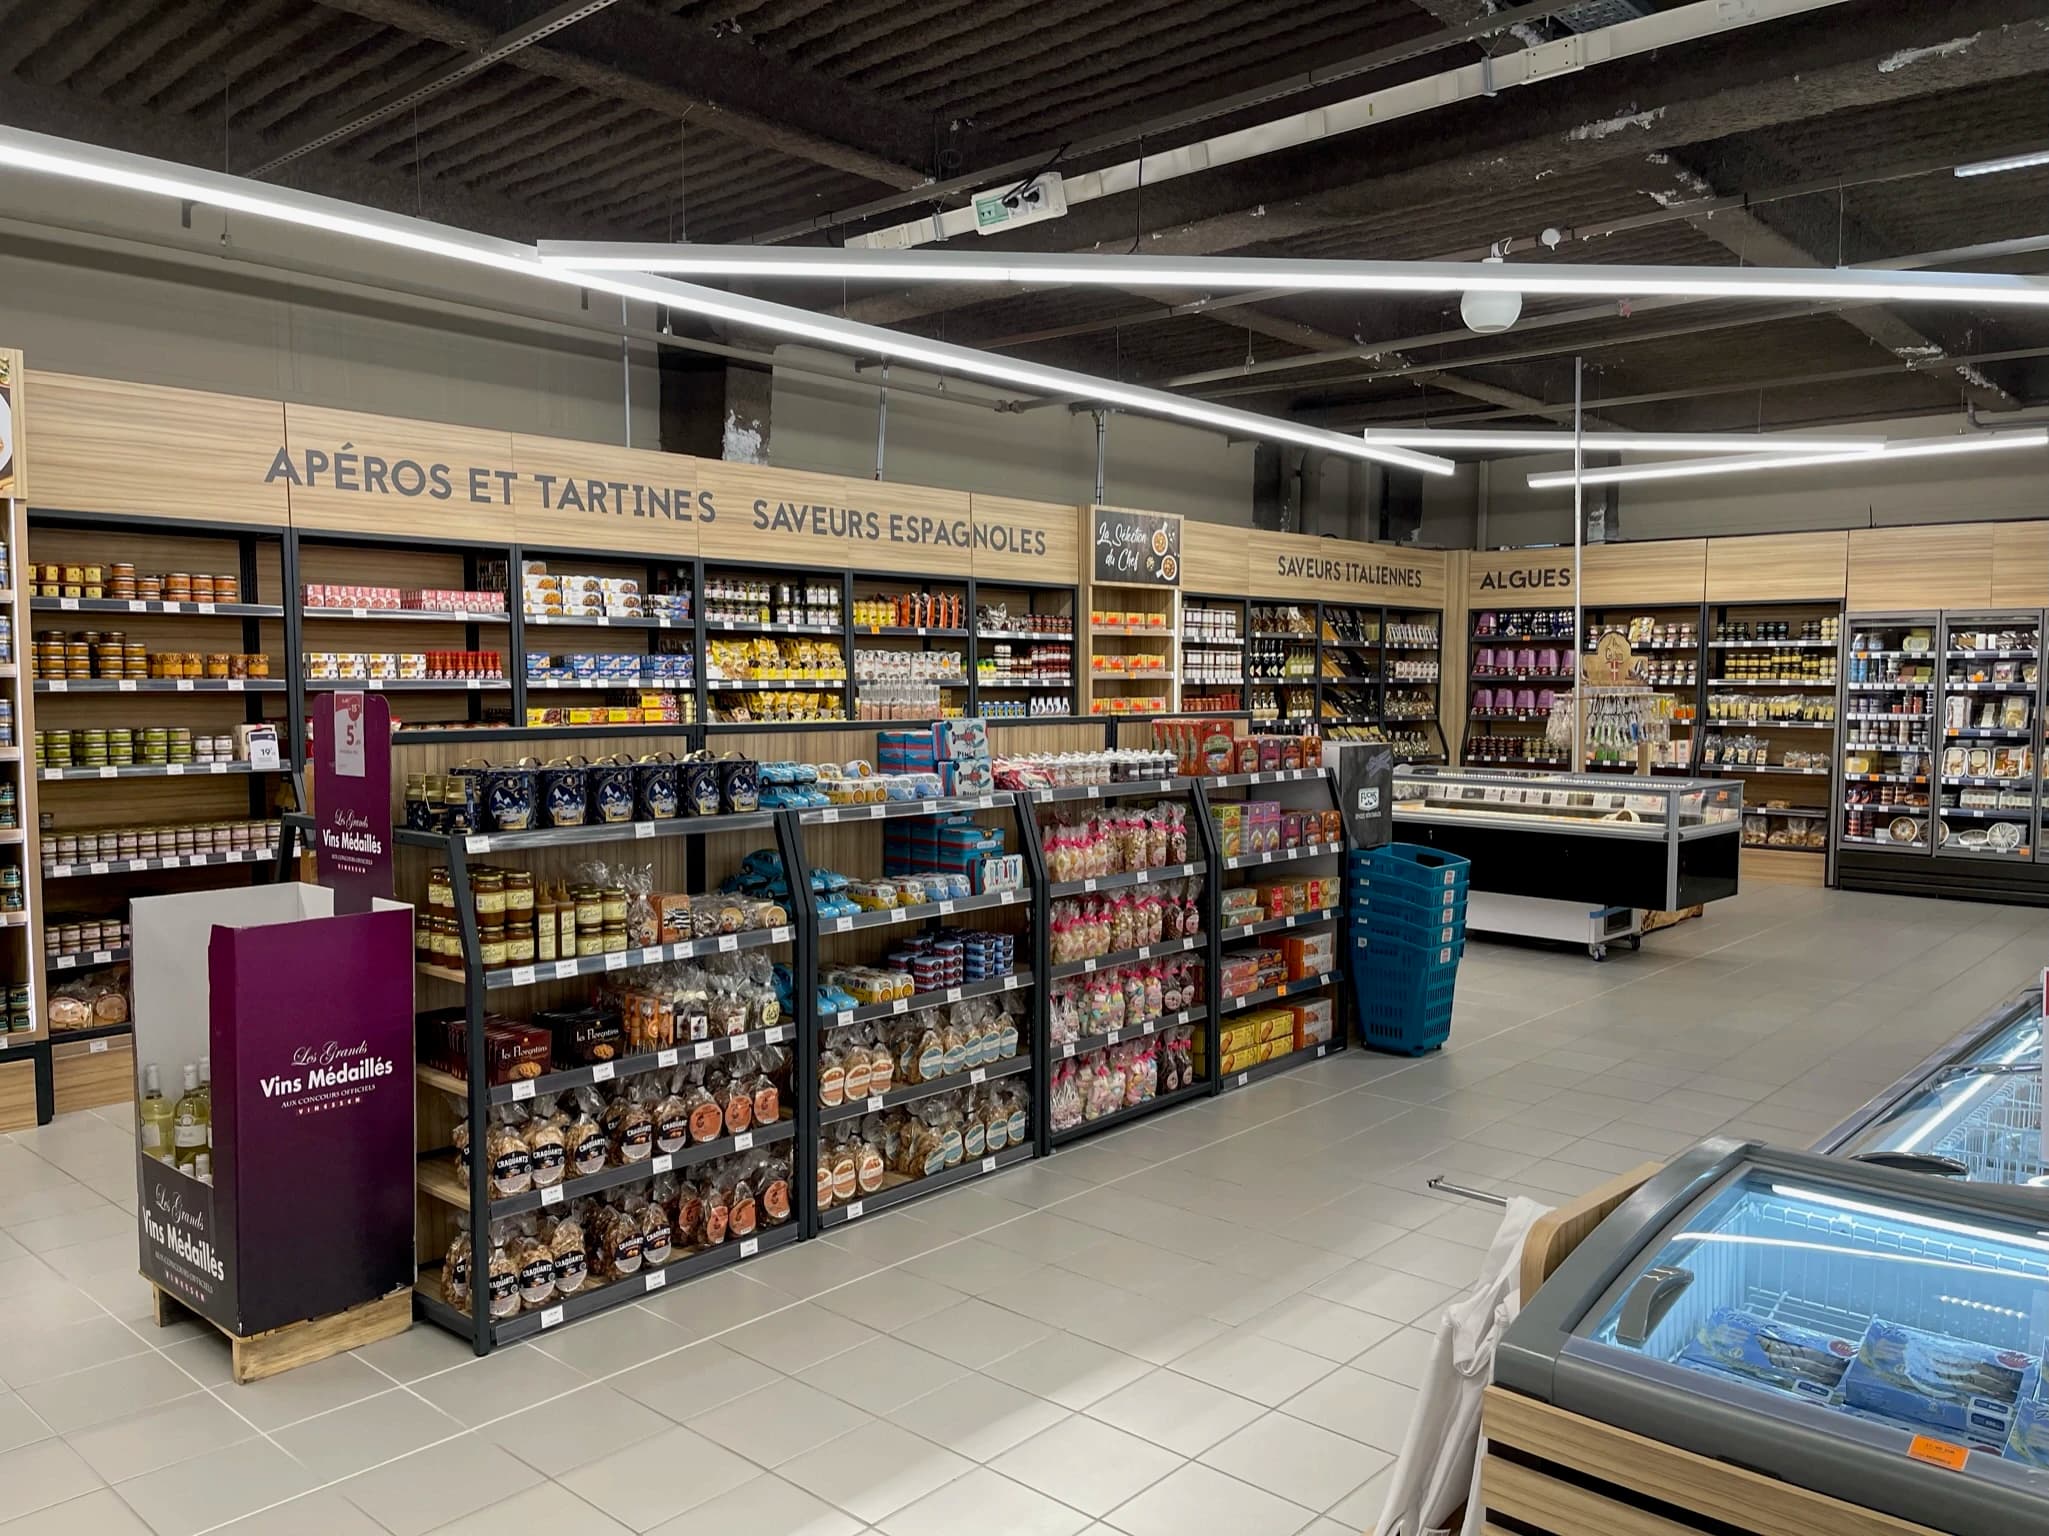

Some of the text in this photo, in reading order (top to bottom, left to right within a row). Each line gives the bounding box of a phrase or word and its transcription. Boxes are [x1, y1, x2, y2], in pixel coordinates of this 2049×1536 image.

[264, 441, 716, 523] APÉROS ET TARTINES
[752, 499, 1047, 556] SAVEURS ESPAGNOLES
[1118, 548, 1140, 572] Chef
[1278, 555, 1422, 589] SAVEURS ITALIENNES
[1479, 568, 1571, 590] ALGUES
[322, 828, 382, 855] Vins Médaillés
[291, 1039, 368, 1067] Les Grands
[259, 1056, 393, 1098] Vins Médaillés
[281, 1083, 376, 1109] AUX CONCOURS OFFICIELS
[496, 1155, 529, 1169] CRAQUANTS
[155, 1183, 205, 1231] Les Grands
[142, 1205, 225, 1281] Vins Médaillés
[522, 1263, 553, 1278] CRAQUANTS
[554, 1254, 585, 1268] CRAQUANTS
